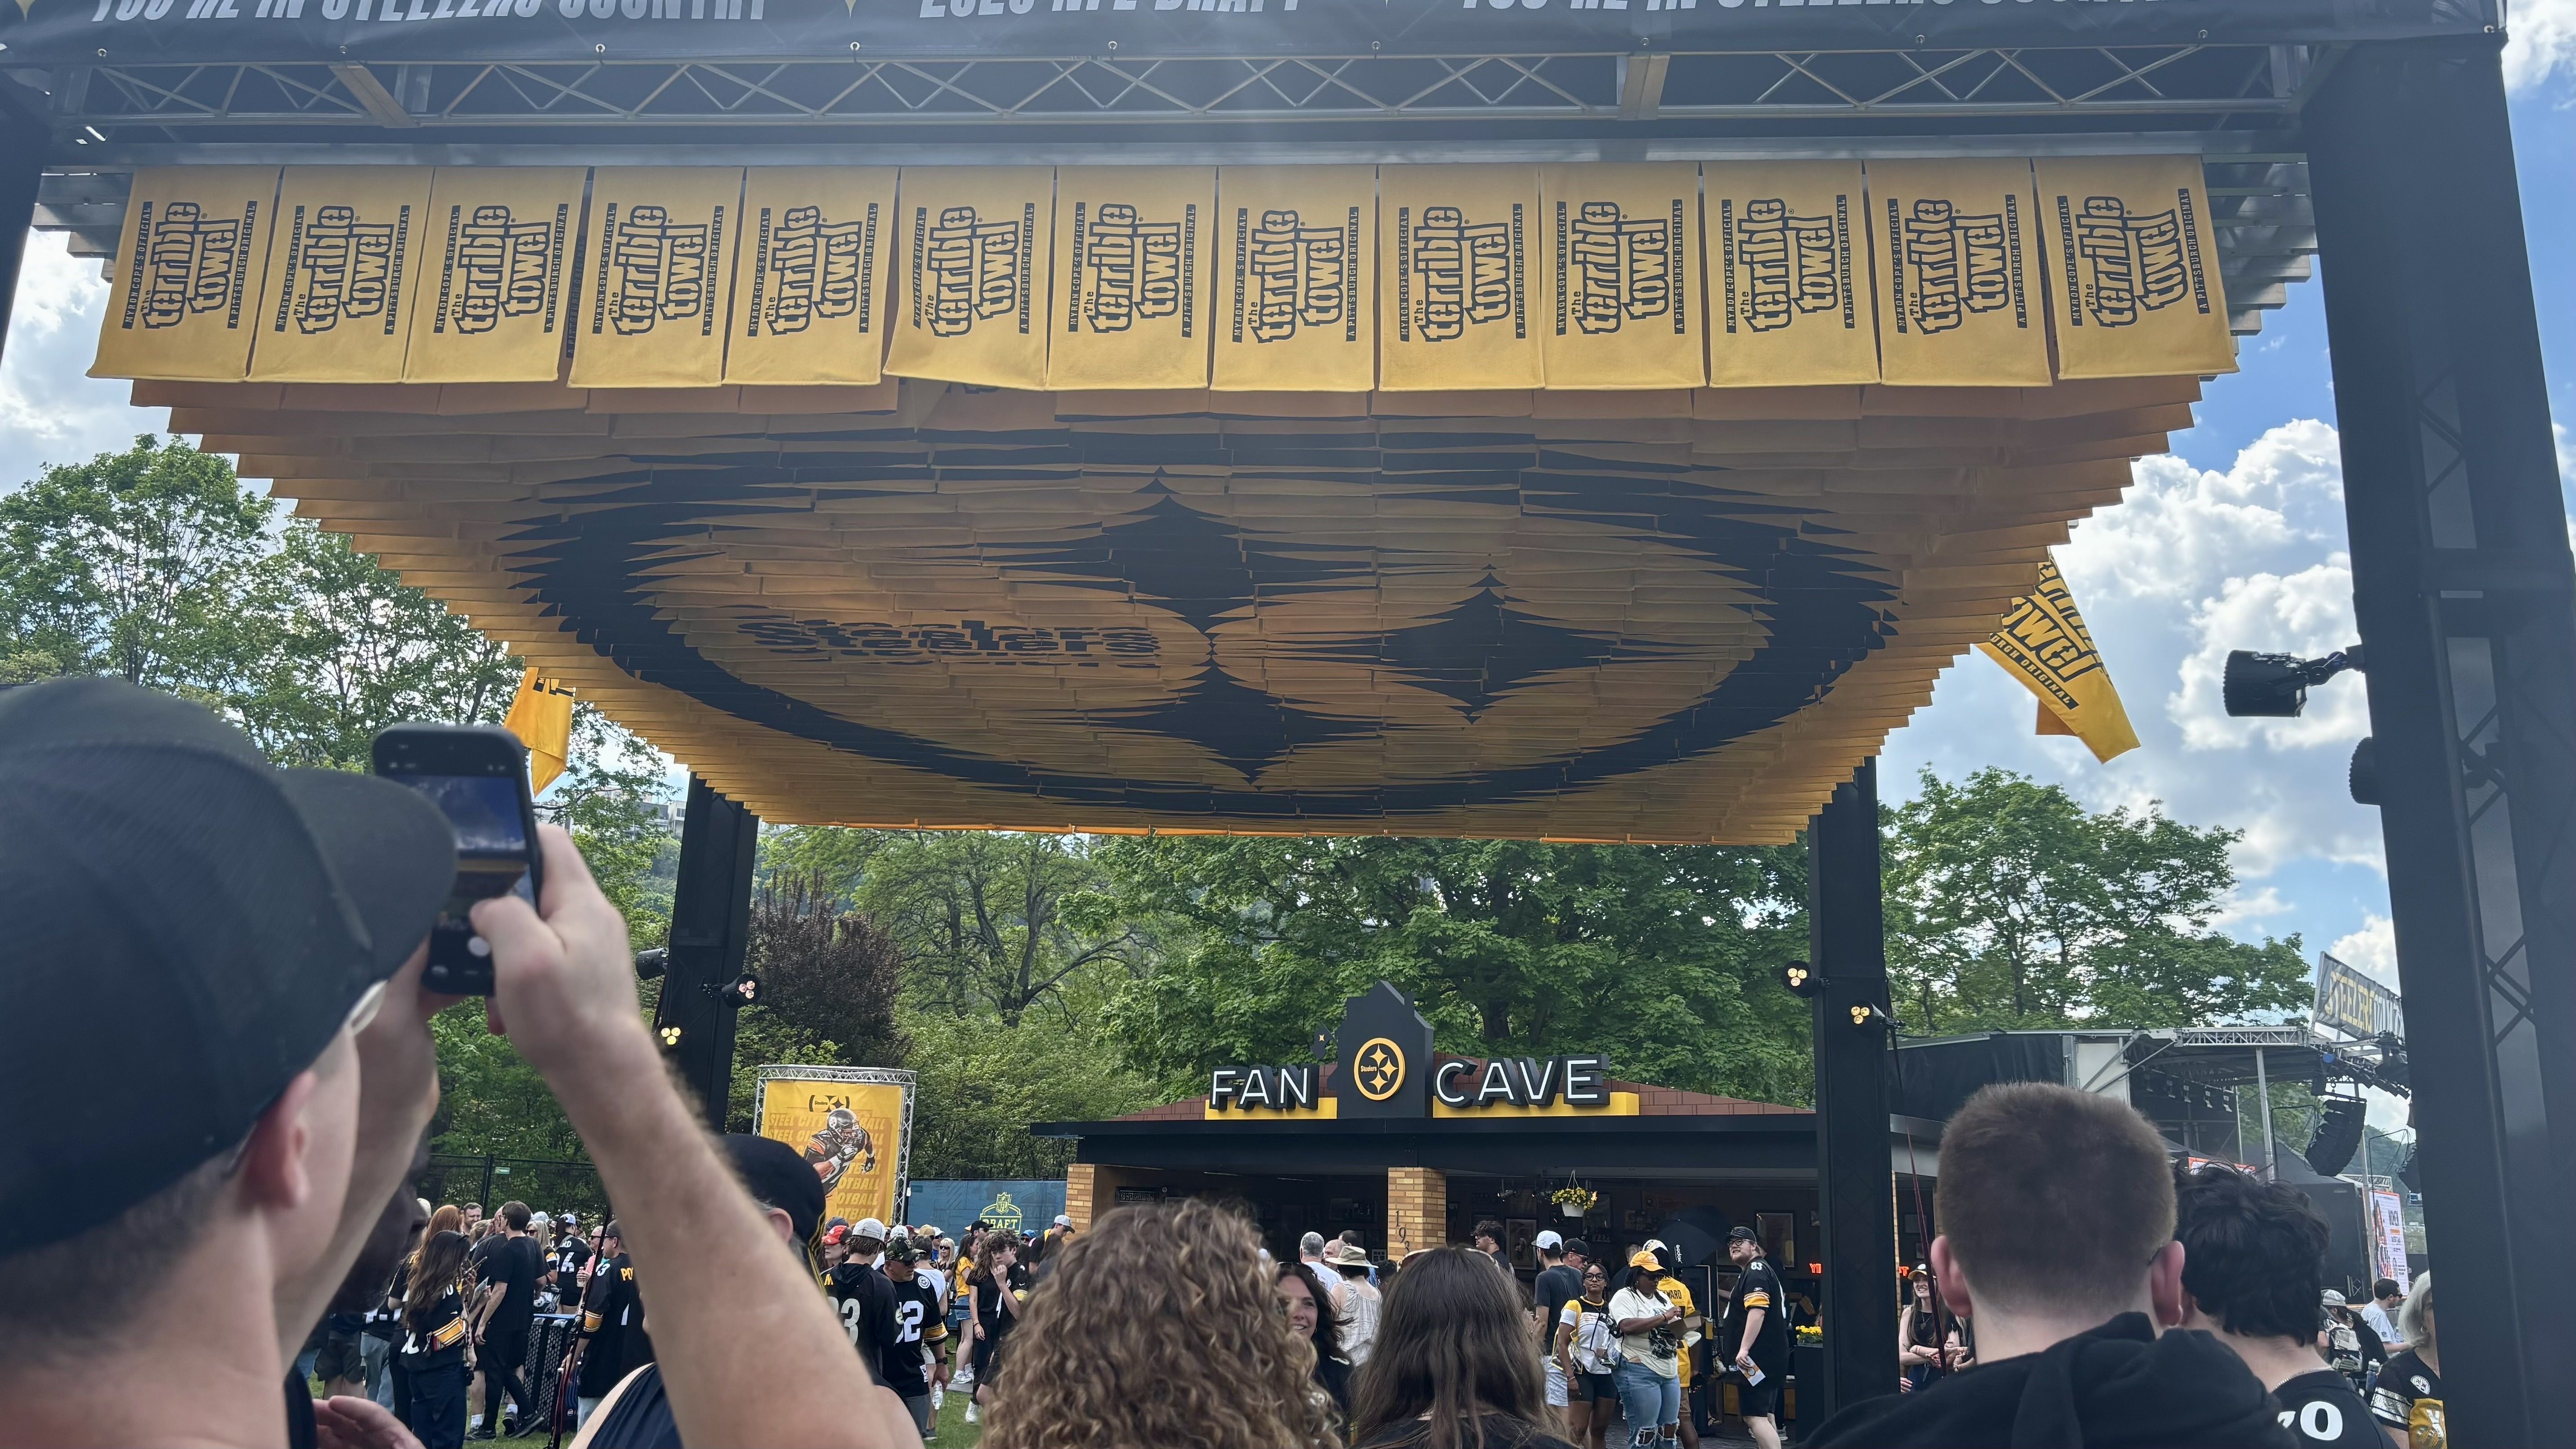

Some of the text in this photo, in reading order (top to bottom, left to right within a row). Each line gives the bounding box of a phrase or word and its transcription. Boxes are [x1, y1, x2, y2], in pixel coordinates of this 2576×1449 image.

[710, 211, 722, 256] ORIGINAL
[865, 207, 876, 252] ORIGINAL
[915, 214, 925, 256] OFFICIAL
[1023, 207, 1033, 253] ORIGINAL
[1185, 209, 1194, 255] ORIGINAL
[1237, 215, 1246, 260] OFFICIAL
[1349, 212, 1357, 258] ORIGINAL
[1514, 209, 1522, 256] ORIGINAL
[1723, 206, 1732, 250] OFFICIAL
[1838, 200, 1848, 247] ORIGINAL
[1890, 206, 1900, 250] OFFICIAL
[2007, 199, 2019, 245] ORIGINAL
[2060, 202, 2072, 244] OFFICIAL
[2180, 193, 2194, 235] ORIGINAL
[125, 292, 138, 322] MYRON
[138, 208, 150, 251] OFFICIAL
[142, 202, 201, 329] terrible
[186, 219, 240, 314] towel
[231, 254, 247, 314] PITTSBURGH
[240, 206, 255, 250] ORIGINAL
[277, 295, 290, 325] MYRON
[290, 212, 303, 255] OFFICIAL
[295, 205, 354, 335] terrible
[340, 224, 395, 318] towel
[387, 259, 402, 320] PITTSBURGH
[396, 210, 408, 255] ORIGINAL
[436, 296, 447, 327] MYRON
[447, 212, 458, 256] OFFICIAL
[454, 205, 511, 334] terrible
[499, 221, 552, 317] towel
[547, 258, 560, 317] PITTSBURGH
[554, 209, 566, 254] ORIGINAL
[594, 294, 604, 326] MYRON
[603, 210, 615, 253] OFFICIAL
[608, 205, 667, 336] terrible
[657, 224, 708, 320] towel
[750, 298, 760, 329] MYRON
[759, 215, 768, 258] OFFICIAL
[767, 205, 821, 336] terrible
[812, 221, 862, 318] towel
[861, 256, 872, 317] PITTSBURGH
[927, 206, 976, 338] terrible
[973, 221, 1019, 321] towel
[1021, 256, 1030, 319] PITTSBURGH
[1070, 294, 1079, 324] MYRON
[1075, 209, 1084, 253] OFFICIAL
[1084, 203, 1137, 333] terrible
[1133, 221, 1181, 319] towel
[1250, 210, 1299, 343] terrible
[1296, 226, 1344, 327] towel
[1413, 206, 1464, 342] terrible
[1464, 222, 1510, 325] towel
[1572, 202, 1621, 335] terrible
[1619, 218, 1670, 320] towel
[1674, 255, 1683, 318] PITTSBURGH
[1737, 198, 1792, 333] terrible
[1791, 215, 1838, 314] towel
[1841, 251, 1852, 313] PITTSBURGH
[1904, 198, 1963, 335] terrible
[1960, 213, 2010, 314] towel
[2012, 249, 2024, 312] PITTSBURGH
[2075, 195, 2138, 328] terrible
[2134, 208, 2188, 311] towel
[2187, 239, 2205, 299] PITTSBURGH
[140, 289, 152, 313] The
[293, 293, 306, 317] The
[451, 293, 463, 317] The
[608, 291, 619, 316] The
[704, 260, 717, 321] PITTSBURGH
[764, 295, 776, 320] The
[925, 294, 934, 317] The
[1084, 290, 1095, 313] The
[1184, 259, 1192, 322] PITTSBURGH
[1234, 303, 1242, 336] MYRON
[1248, 301, 1258, 325] The
[1348, 263, 1356, 326] PITTSBURGH
[1414, 299, 1423, 323] The
[1515, 260, 1523, 322] PITTSBURGH
[1572, 290, 1581, 315] The
[1726, 293, 1734, 326] MYRON
[1740, 290, 1749, 315] The
[1895, 294, 1905, 326] MYRON
[1909, 291, 1918, 317] The
[2070, 285, 2080, 318] MYRON
[2085, 283, 2094, 308] The
[2020, 659, 2070, 704] ORIGINAL
[1210, 1056, 1604, 1107] FAN CAVE
[769, 1113, 794, 1127] STEEL
[859, 1118, 885, 1131] BALL
[837, 1177, 879, 1191] OTBALL
[837, 1192, 879, 1205] OTBALL
[837, 1208, 878, 1220] OTBALL
[997, 1202, 1007, 1210] NFL
[1750, 1261, 1762, 1271] 83
[895, 1300, 925, 1343] 2
